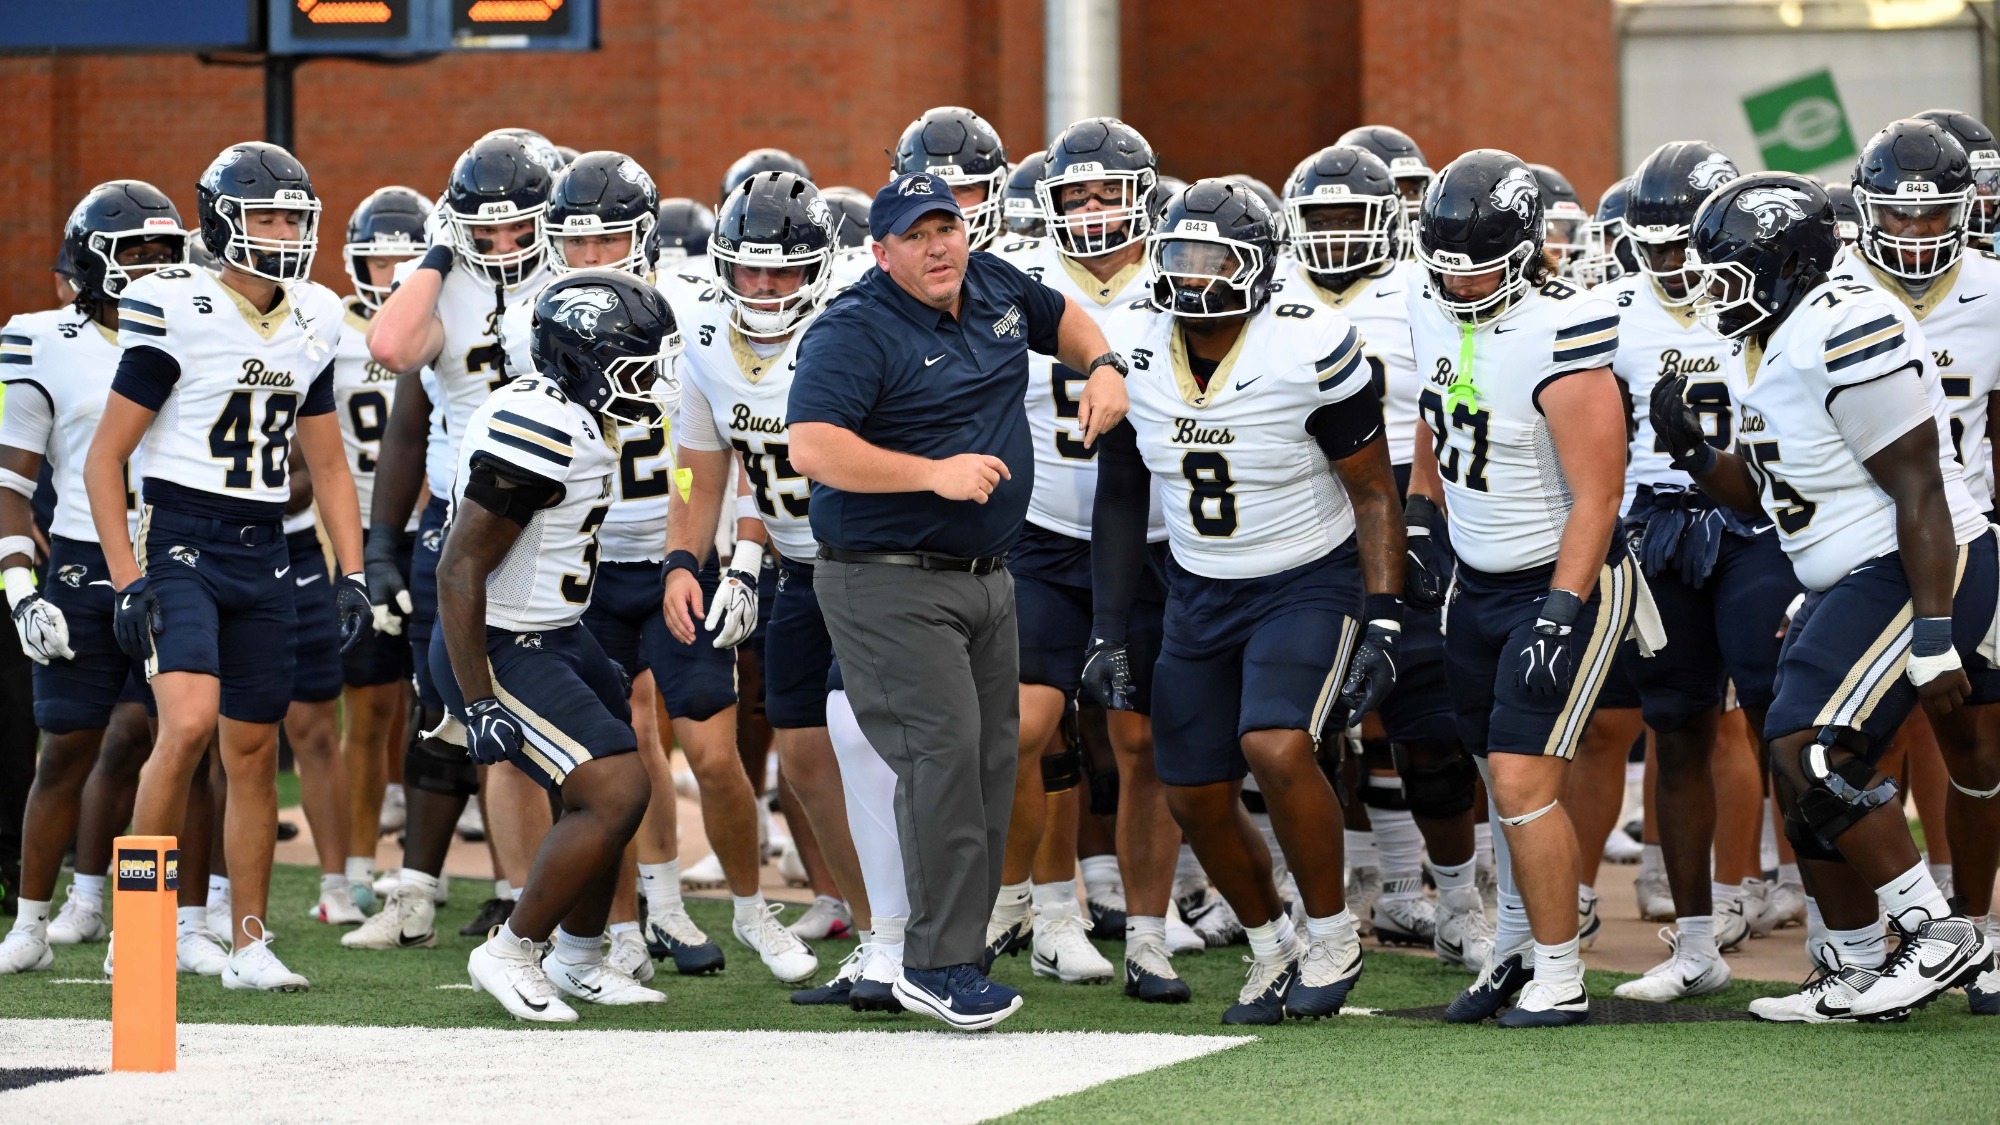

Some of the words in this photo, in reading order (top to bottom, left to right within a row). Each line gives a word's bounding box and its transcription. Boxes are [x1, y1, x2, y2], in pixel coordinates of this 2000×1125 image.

[1979, 151, 1996, 160] 843
[933, 167, 955, 177] 843
[1072, 163, 1094, 173] 843
[283, 191, 303, 200] 843
[1321, 186, 1343, 195] 843
[1905, 183, 1930, 193] 843
[487, 204, 509, 215] 843
[149, 219, 175, 227] Riddell
[570, 217, 592, 227] 843
[1185, 221, 1208, 232] 843
[748, 247, 774, 256] LIGHT
[1439, 254, 1461, 267] 843
[1537, 279, 1577, 302] 8
[1808, 283, 1876, 310] 75
[1274, 302, 1316, 321] 8
[669, 336, 682, 348] 843
[1657, 348, 1721, 377] Bucs
[237, 358, 295, 388] Bucs
[728, 402, 786, 434] Bucs
[1652, 379, 1736, 456] 8
[207, 389, 298, 491] 48
[1171, 416, 1236, 446] Bucs
[1416, 385, 1493, 494] 87
[729, 434, 812, 521] 45
[1179, 449, 1241, 540] 8
[1738, 438, 1820, 538] 75
[119, 859, 156, 880] SBC
[1966, 942, 1983, 960] ALPHA
